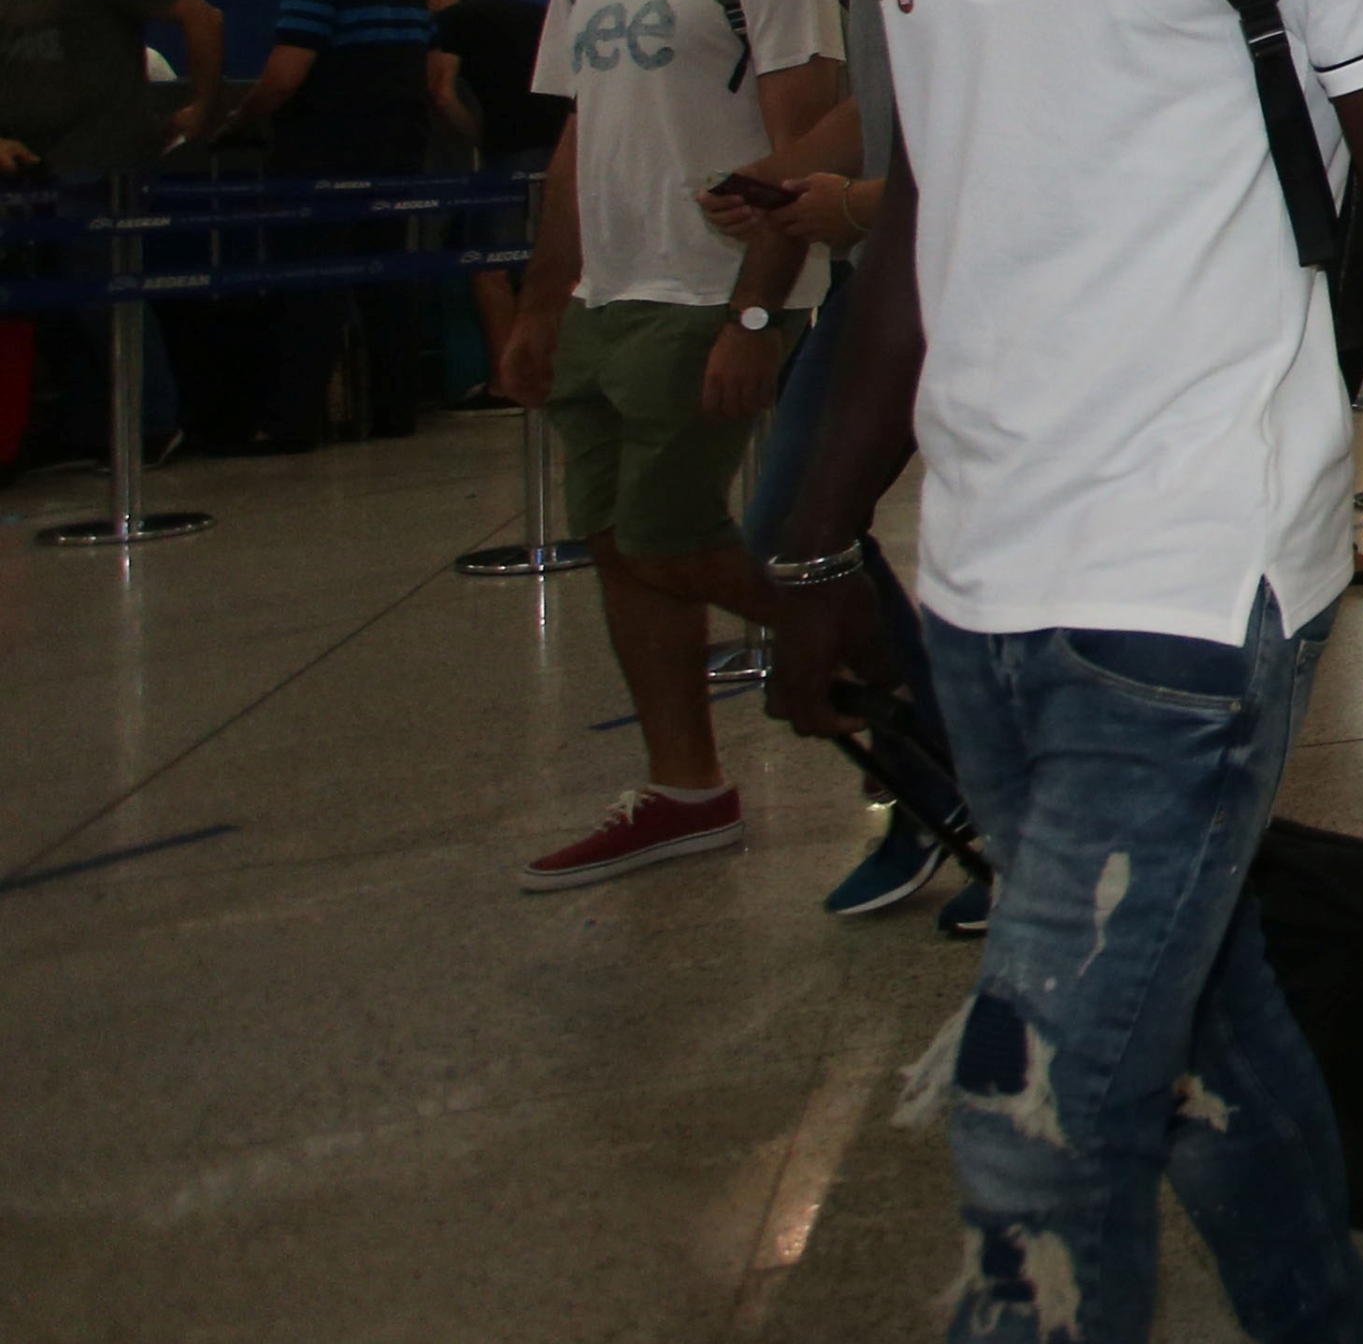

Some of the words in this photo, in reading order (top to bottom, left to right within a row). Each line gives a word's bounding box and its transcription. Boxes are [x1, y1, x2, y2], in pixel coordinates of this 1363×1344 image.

[394, 199, 439, 210] AEGEAN
[116, 216, 172, 229] AEGEAN
[142, 275, 211, 291] AEGEAN
